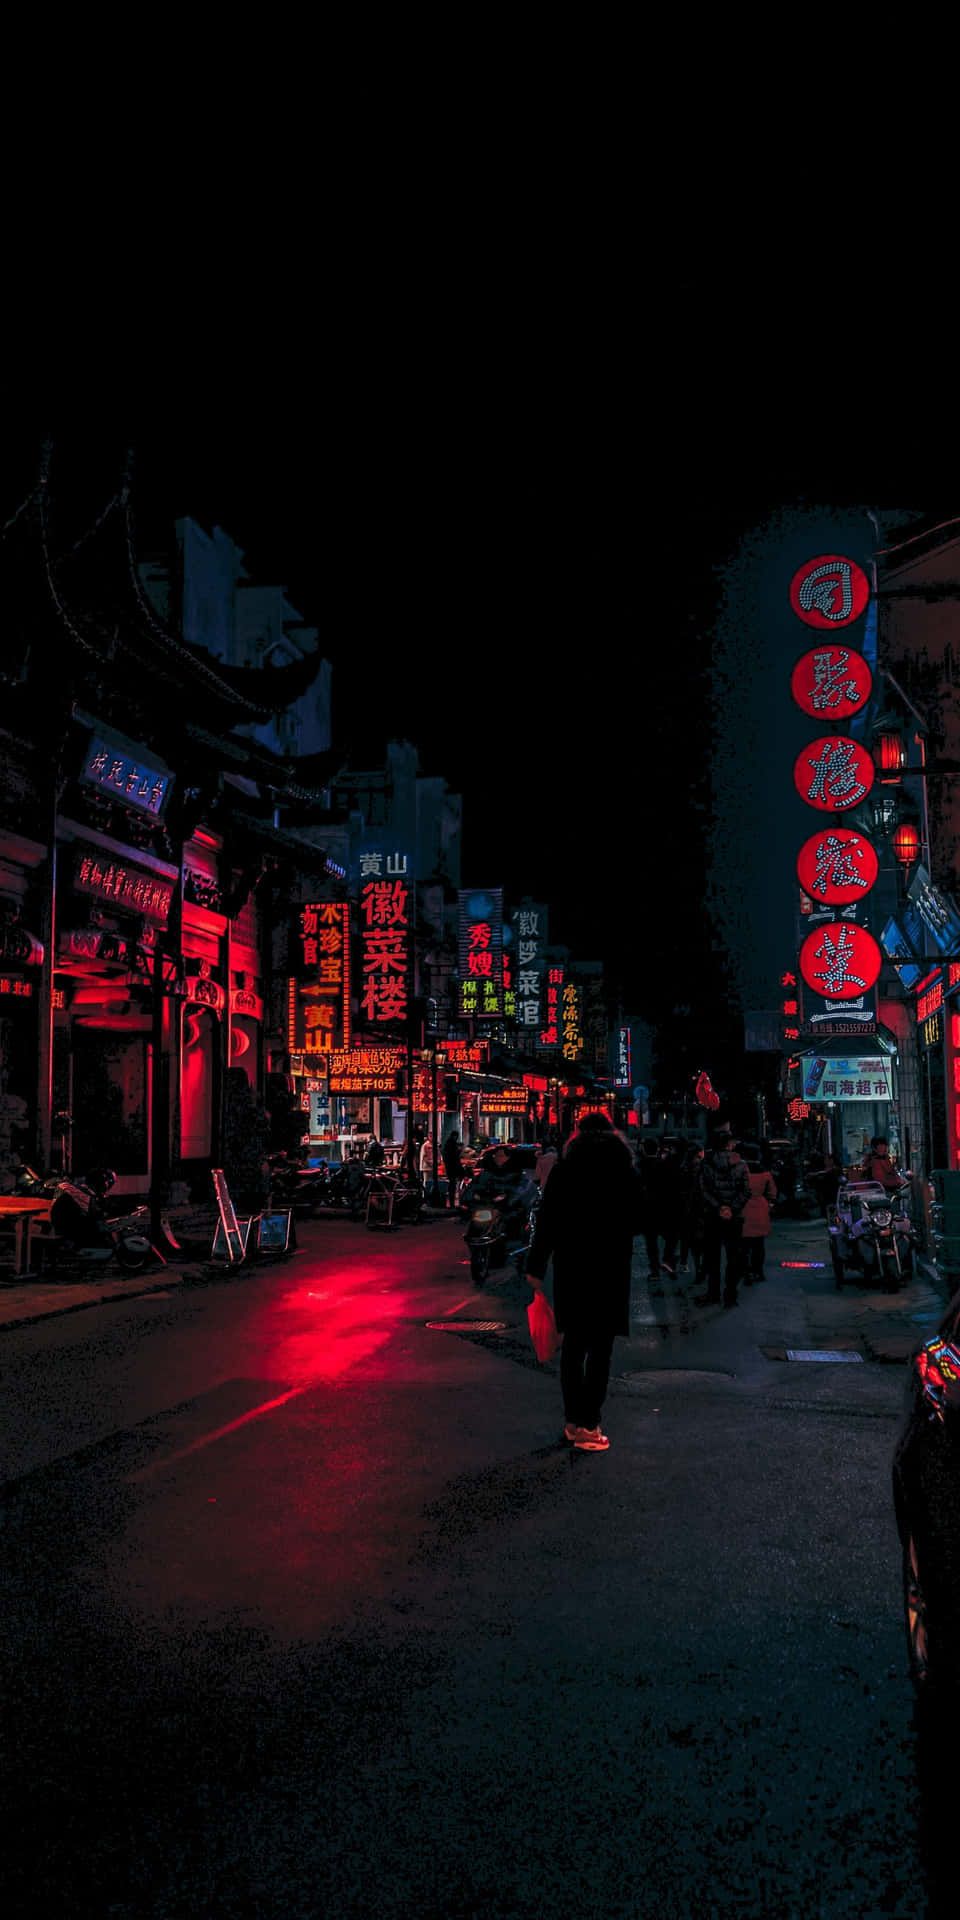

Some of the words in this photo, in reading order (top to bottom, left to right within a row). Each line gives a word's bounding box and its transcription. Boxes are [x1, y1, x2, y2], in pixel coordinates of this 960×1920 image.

[360, 853, 408, 877] 黄山
[361, 879, 409, 1021] 徽菜楼
[467, 922, 493, 977] 秀嫂
[303, 1004, 335, 1052] 黄山
[822, 1080, 888, 1097] 阿海超市
